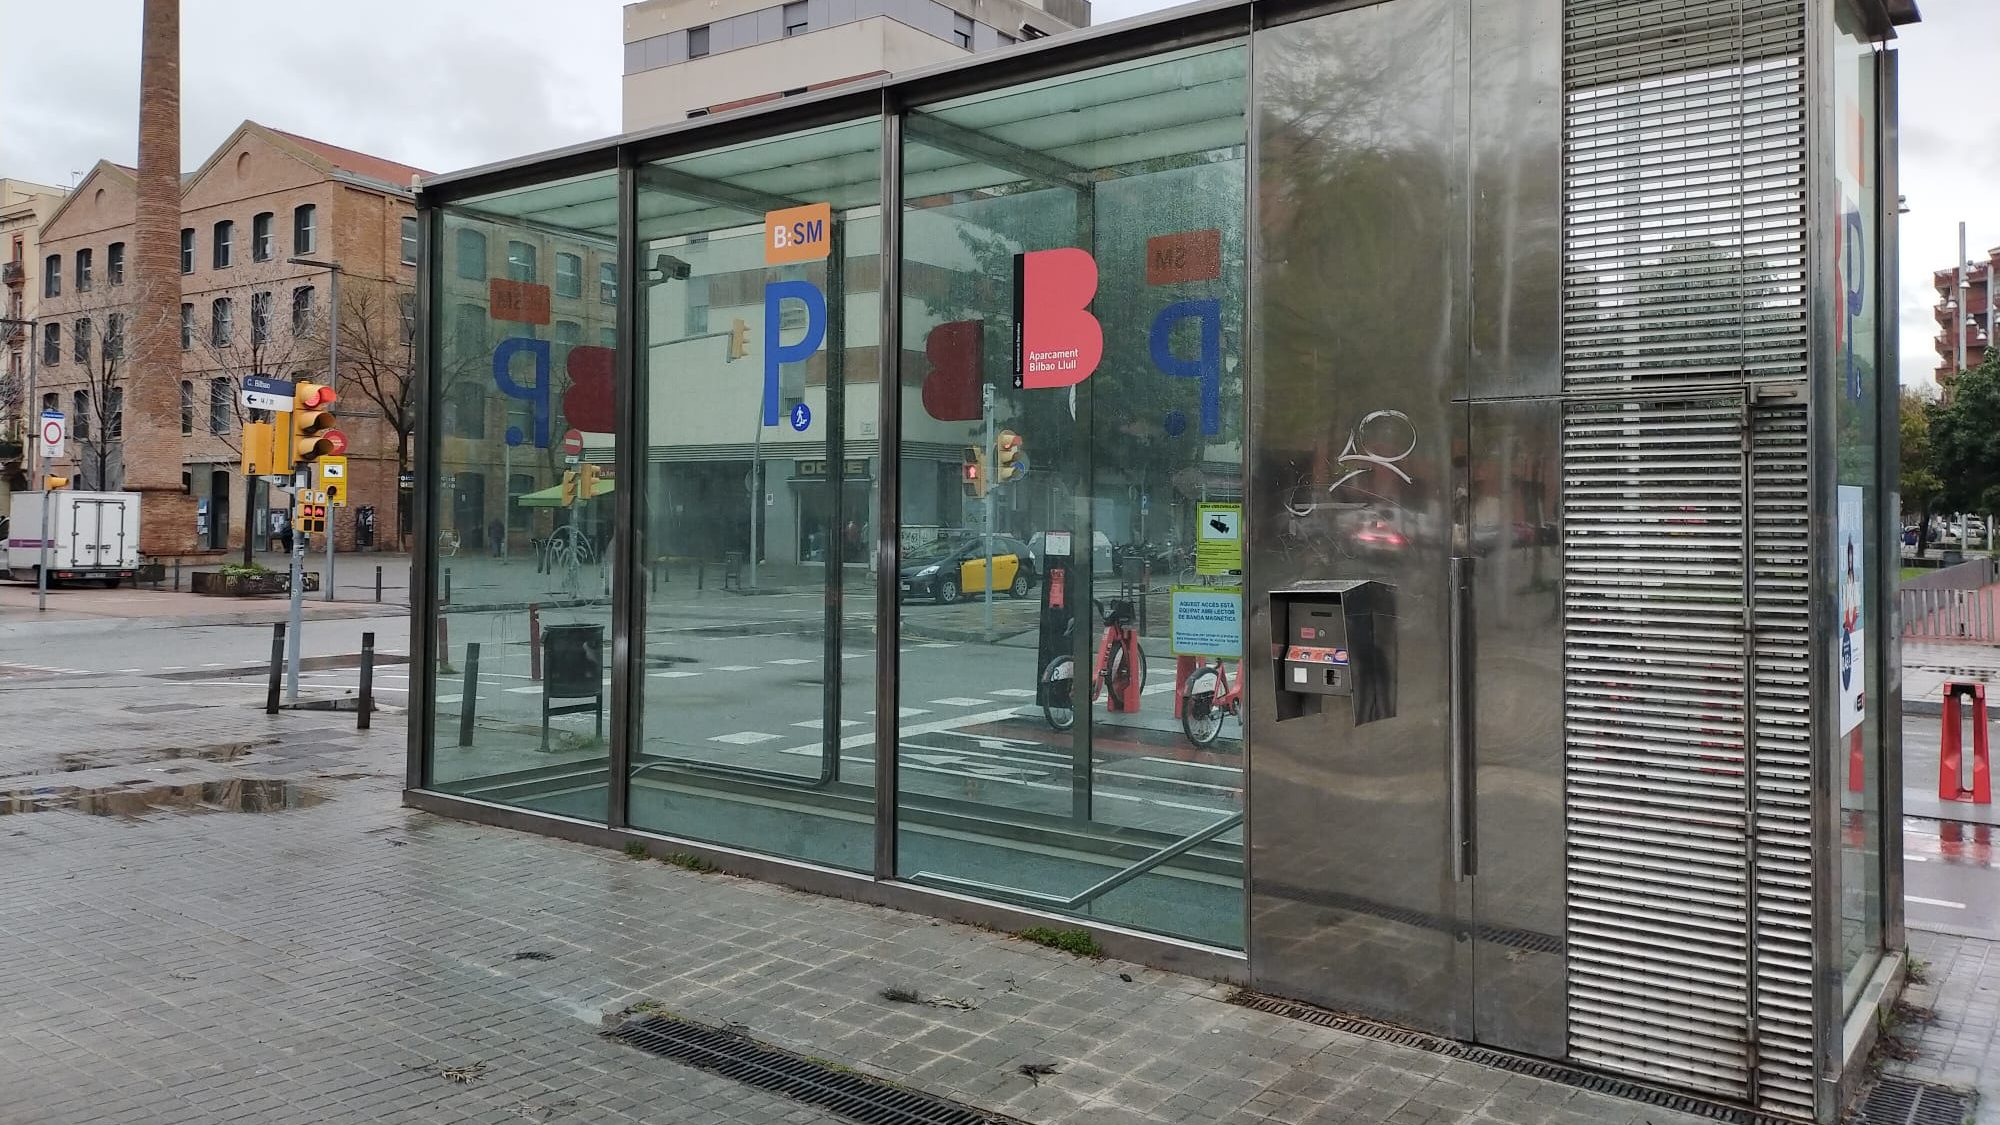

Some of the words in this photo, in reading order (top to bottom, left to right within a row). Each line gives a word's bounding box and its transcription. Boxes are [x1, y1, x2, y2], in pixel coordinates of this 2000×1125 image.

[774, 219, 823, 248] B:SM
[764, 281, 827, 427] P
[1029, 348, 1079, 361] Aparcament
[1029, 362, 1055, 372] Bilbao
[1058, 360, 1077, 370] Llull
[247, 378, 253, 386] C.
[254, 380, 271, 389] Bilbao
